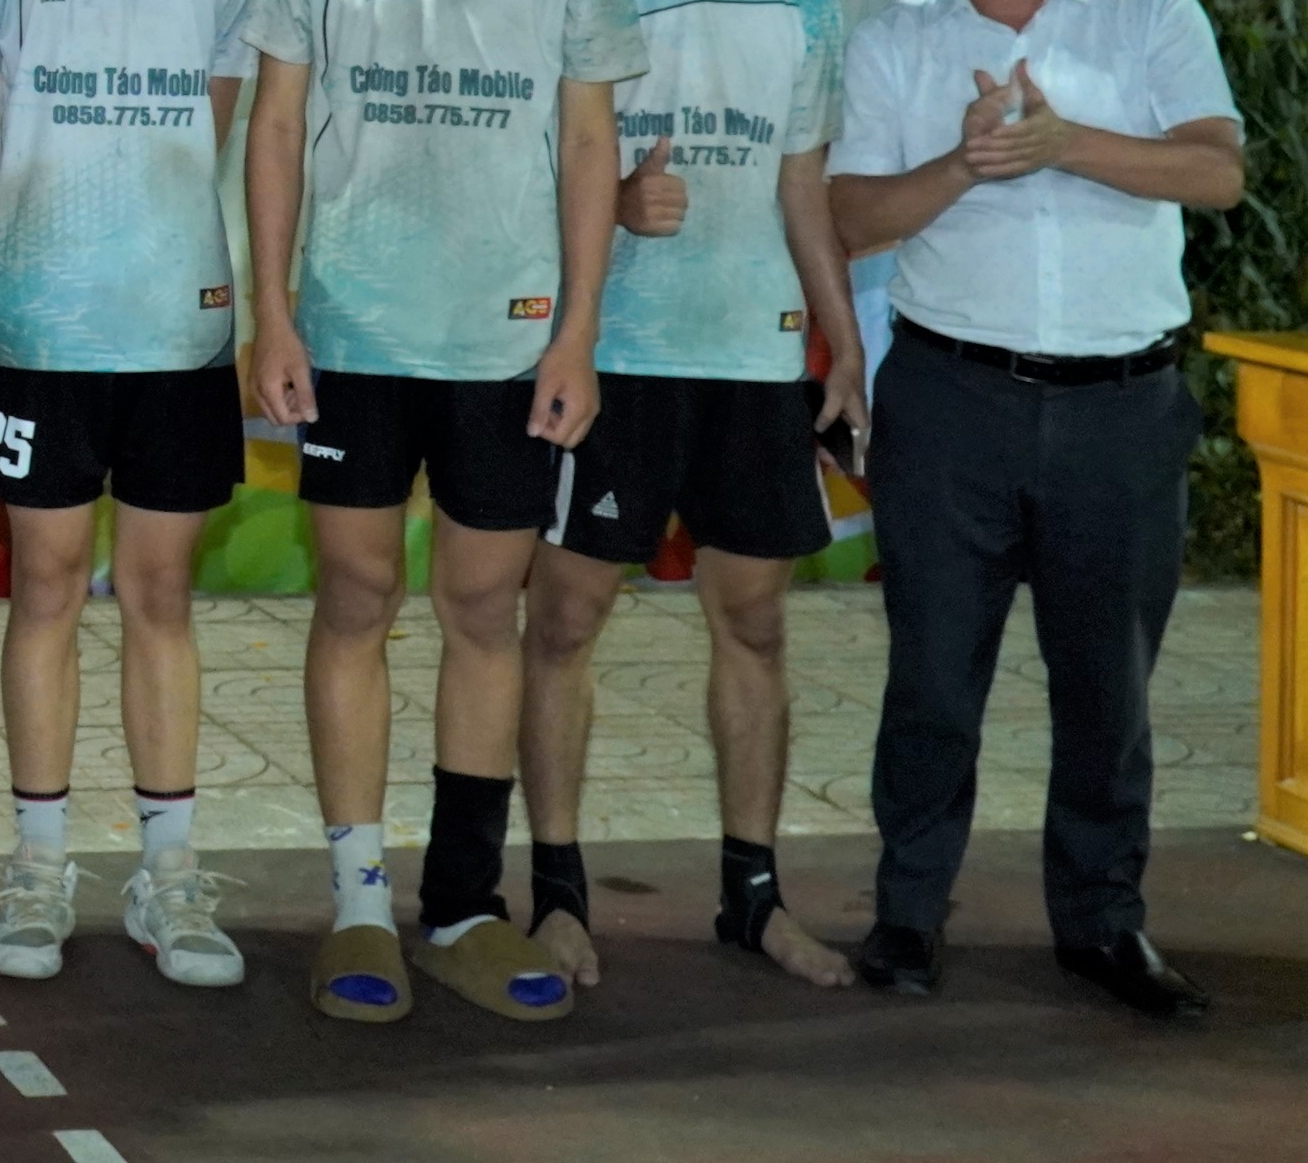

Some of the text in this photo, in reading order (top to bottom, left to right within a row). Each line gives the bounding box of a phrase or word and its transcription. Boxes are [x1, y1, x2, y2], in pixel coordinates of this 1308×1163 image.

[34, 65, 210, 98] Cường Táo Mobil
[350, 62, 534, 101] Cường Táo Mobile
[53, 104, 194, 127] 0858.775.777
[363, 102, 511, 129] 0858.775.777
[681, 106, 716, 134] Táo
